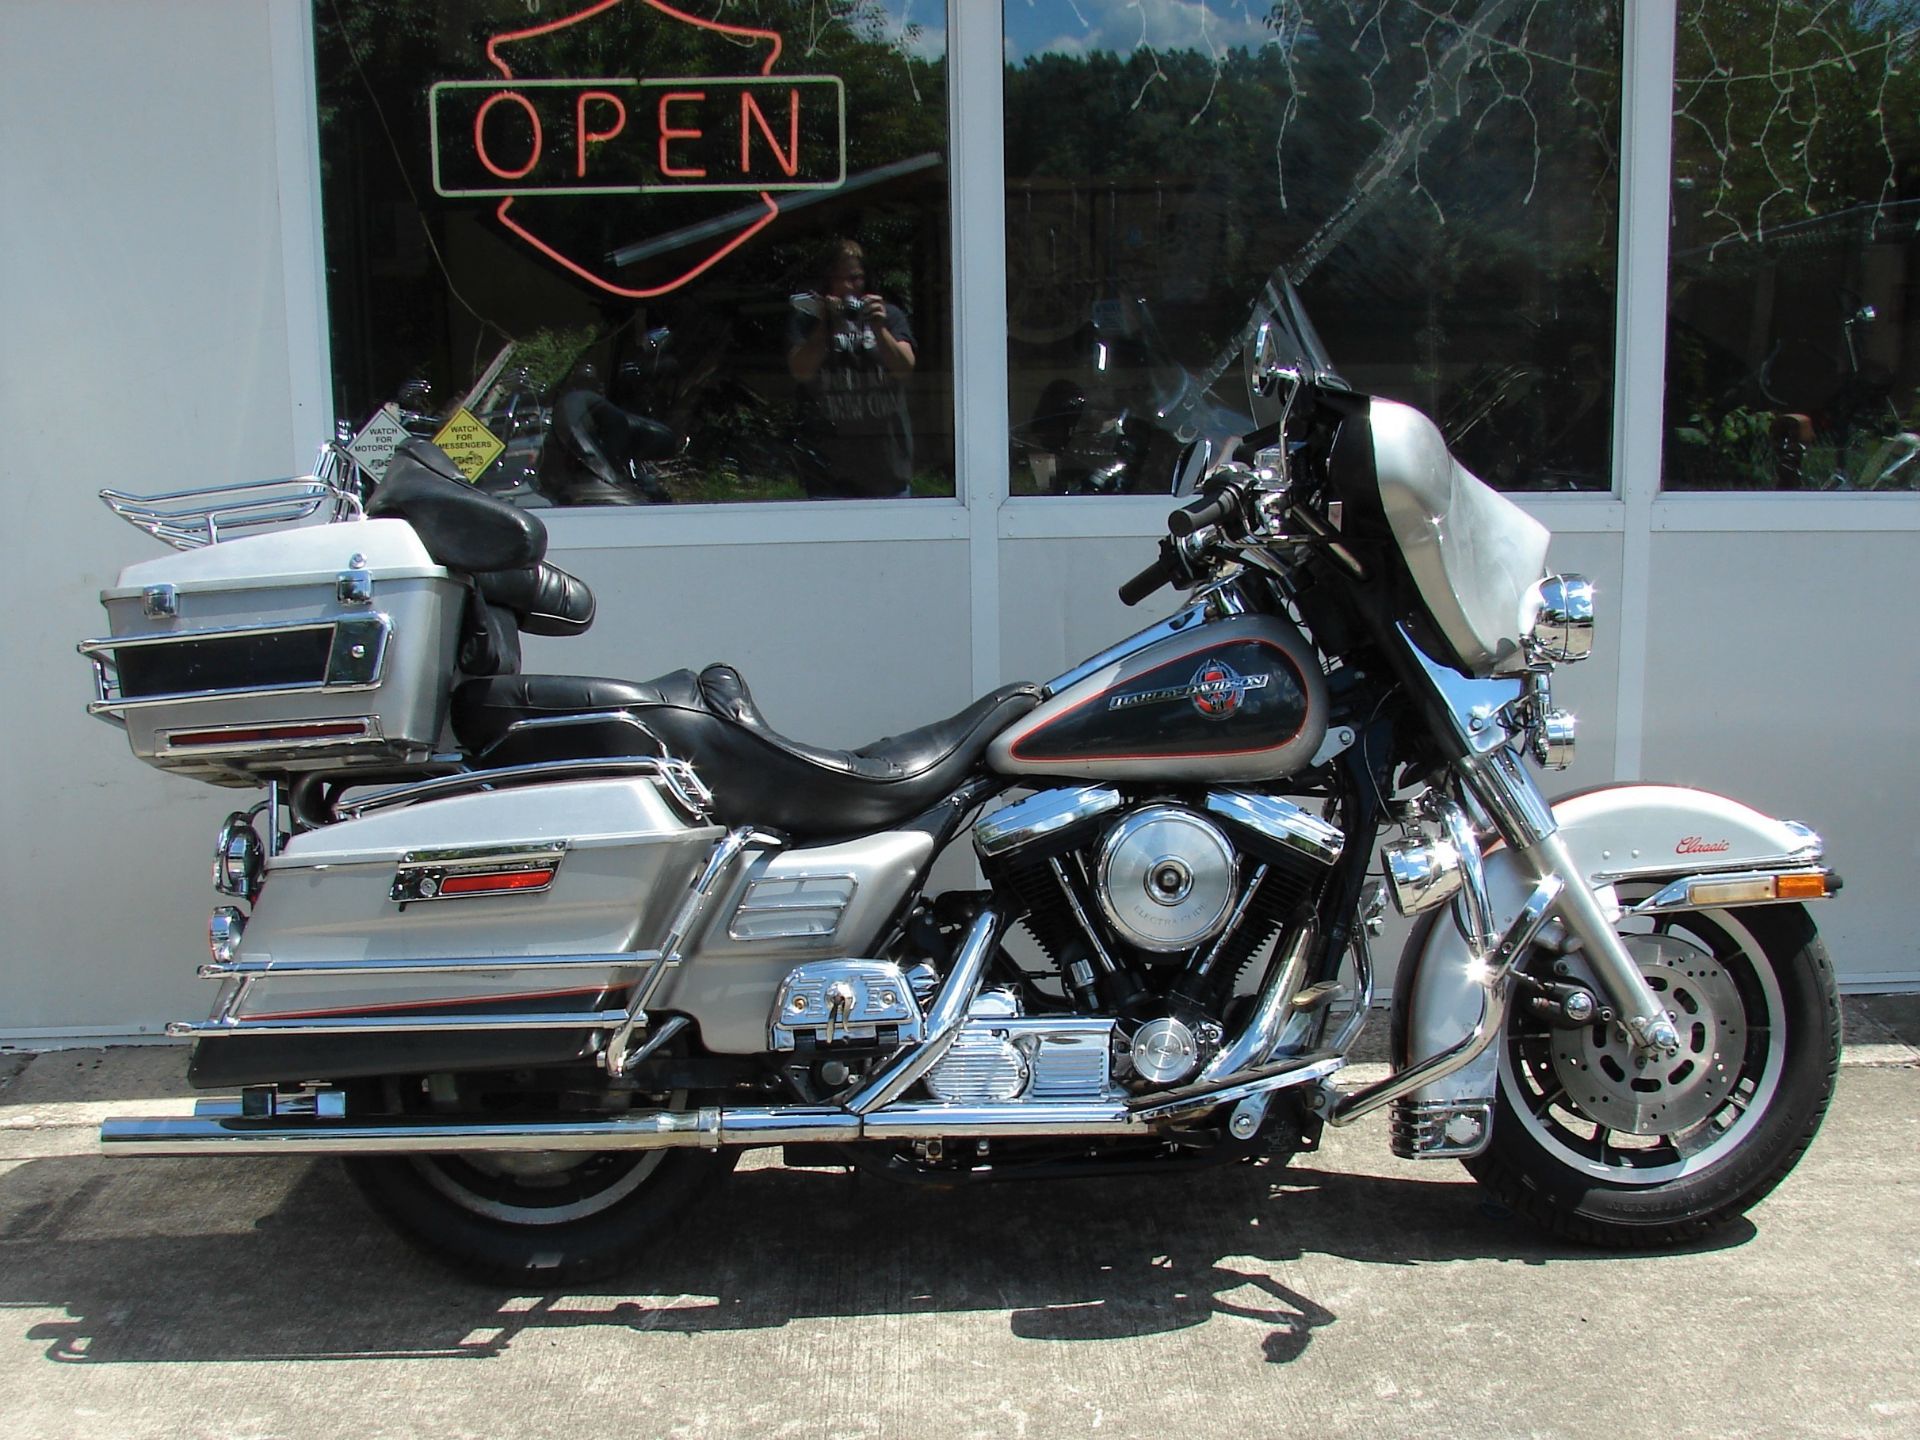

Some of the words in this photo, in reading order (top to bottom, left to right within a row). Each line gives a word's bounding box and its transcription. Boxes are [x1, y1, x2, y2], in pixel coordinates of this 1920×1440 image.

[474, 89, 799, 179] OPEN
[369, 427, 398, 435] WATCH
[451, 425, 478, 433] WATCH
[456, 433, 473, 441] FOR
[1114, 674, 1267, 707] HARLEY-DAVIDSON
[1675, 836, 1730, 854] Classic
